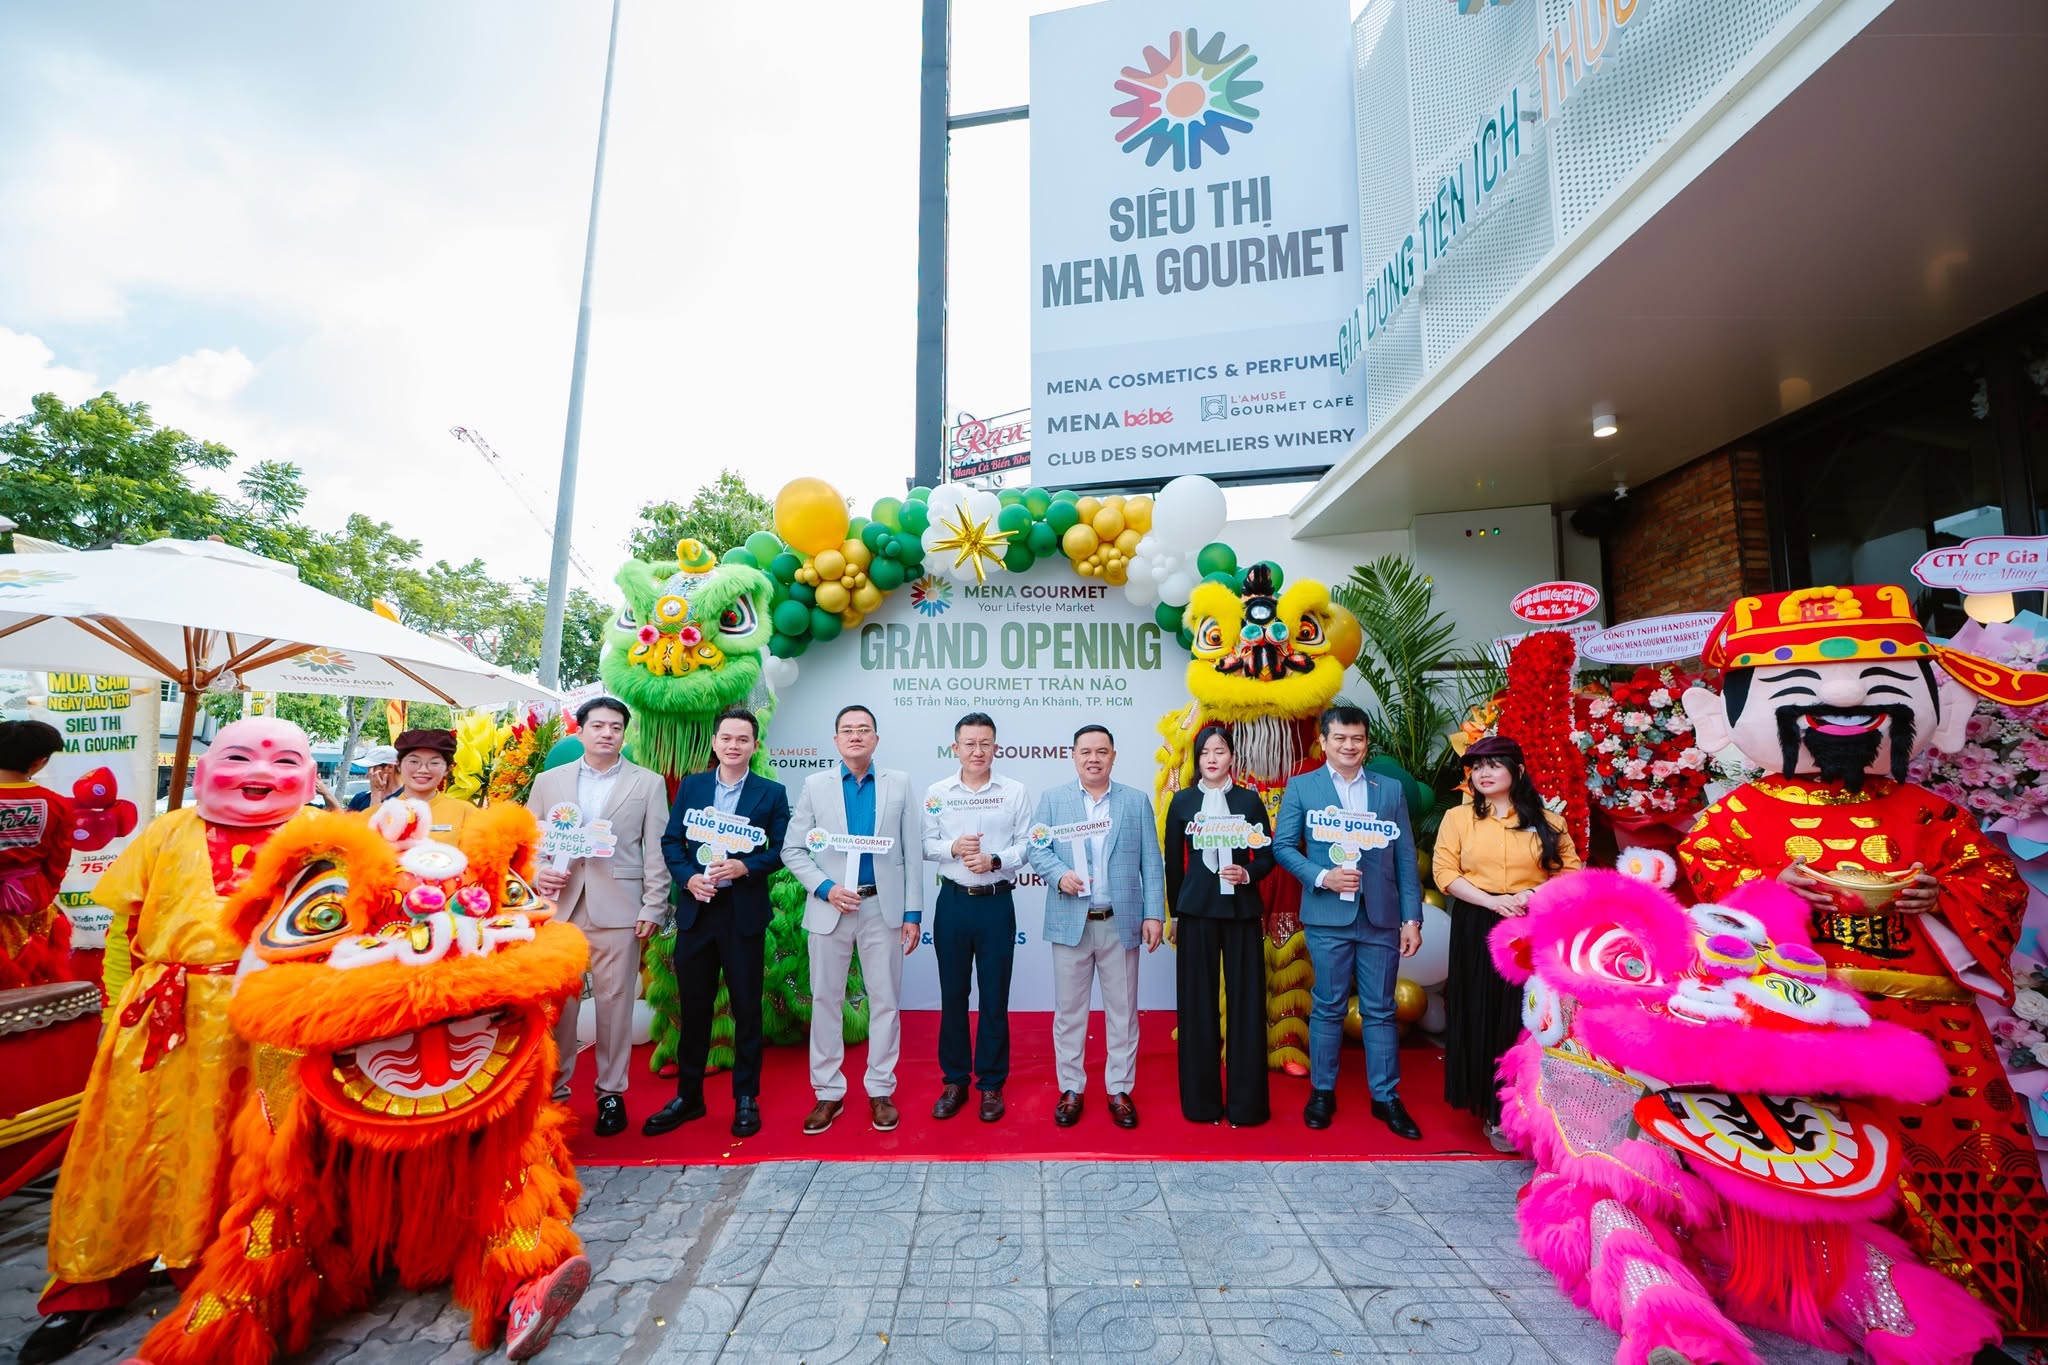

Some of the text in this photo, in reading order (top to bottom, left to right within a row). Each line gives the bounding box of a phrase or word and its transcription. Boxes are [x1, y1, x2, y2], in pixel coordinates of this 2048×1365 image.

[1109, 175, 1272, 242] SIÊU THỊ
[1338, 87, 1520, 375] GIA DỤNG TIỆN ÍCH
[1042, 224, 1348, 308] MENA GOURMET
[1047, 378, 1102, 395] MENA
[1108, 366, 1217, 389] COSMETICS
[1225, 364, 1239, 377] &
[1230, 394, 1354, 416] GOURMET CAFÉ
[1231, 391, 1287, 404] L'AMUSE
[1048, 406, 1174, 434] MENA bébé
[1048, 428, 1355, 466] CLUB DES SOMMELIERS WINERY
[1933, 549, 2039, 568] CTY CP Gia
[964, 585, 1108, 599] MENA GOURMET
[978, 602, 1095, 613] Your Lifestyle Market
[1604, 617, 1716, 641] CÔNG TY TNHH HAND&HAND
[860, 621, 1162, 670] GRAND OPENING
[1625, 640, 1642, 650] MENA
[1643, 636, 1673, 648] GOURMET
[1673, 633, 1700, 643] MARKET
[48, 671, 91, 694] MUA
[893, 675, 1127, 691] MENA GOURMET TRẦN NÃO
[894, 695, 1133, 708] 165 Trần Não, Phường An Khánh, TP. HCM
[63, 735, 138, 753] NA GOURMET
[770, 748, 818, 756] L'AMUSE
[993, 746, 1075, 759] GOURMET
[768, 759, 834, 768] GOURMET
[969, 798, 1004, 806] GOURMET
[687, 812, 763, 842] Live young,
[1054, 820, 1110, 836] MENA GOURMET
[1187, 822, 1203, 836] My
[1310, 813, 1397, 836] Live young,
[689, 825, 752, 850] live style
[855, 838, 891, 847] GOURMET
[1316, 826, 1385, 847] live style
[560, 841, 592, 855] style
